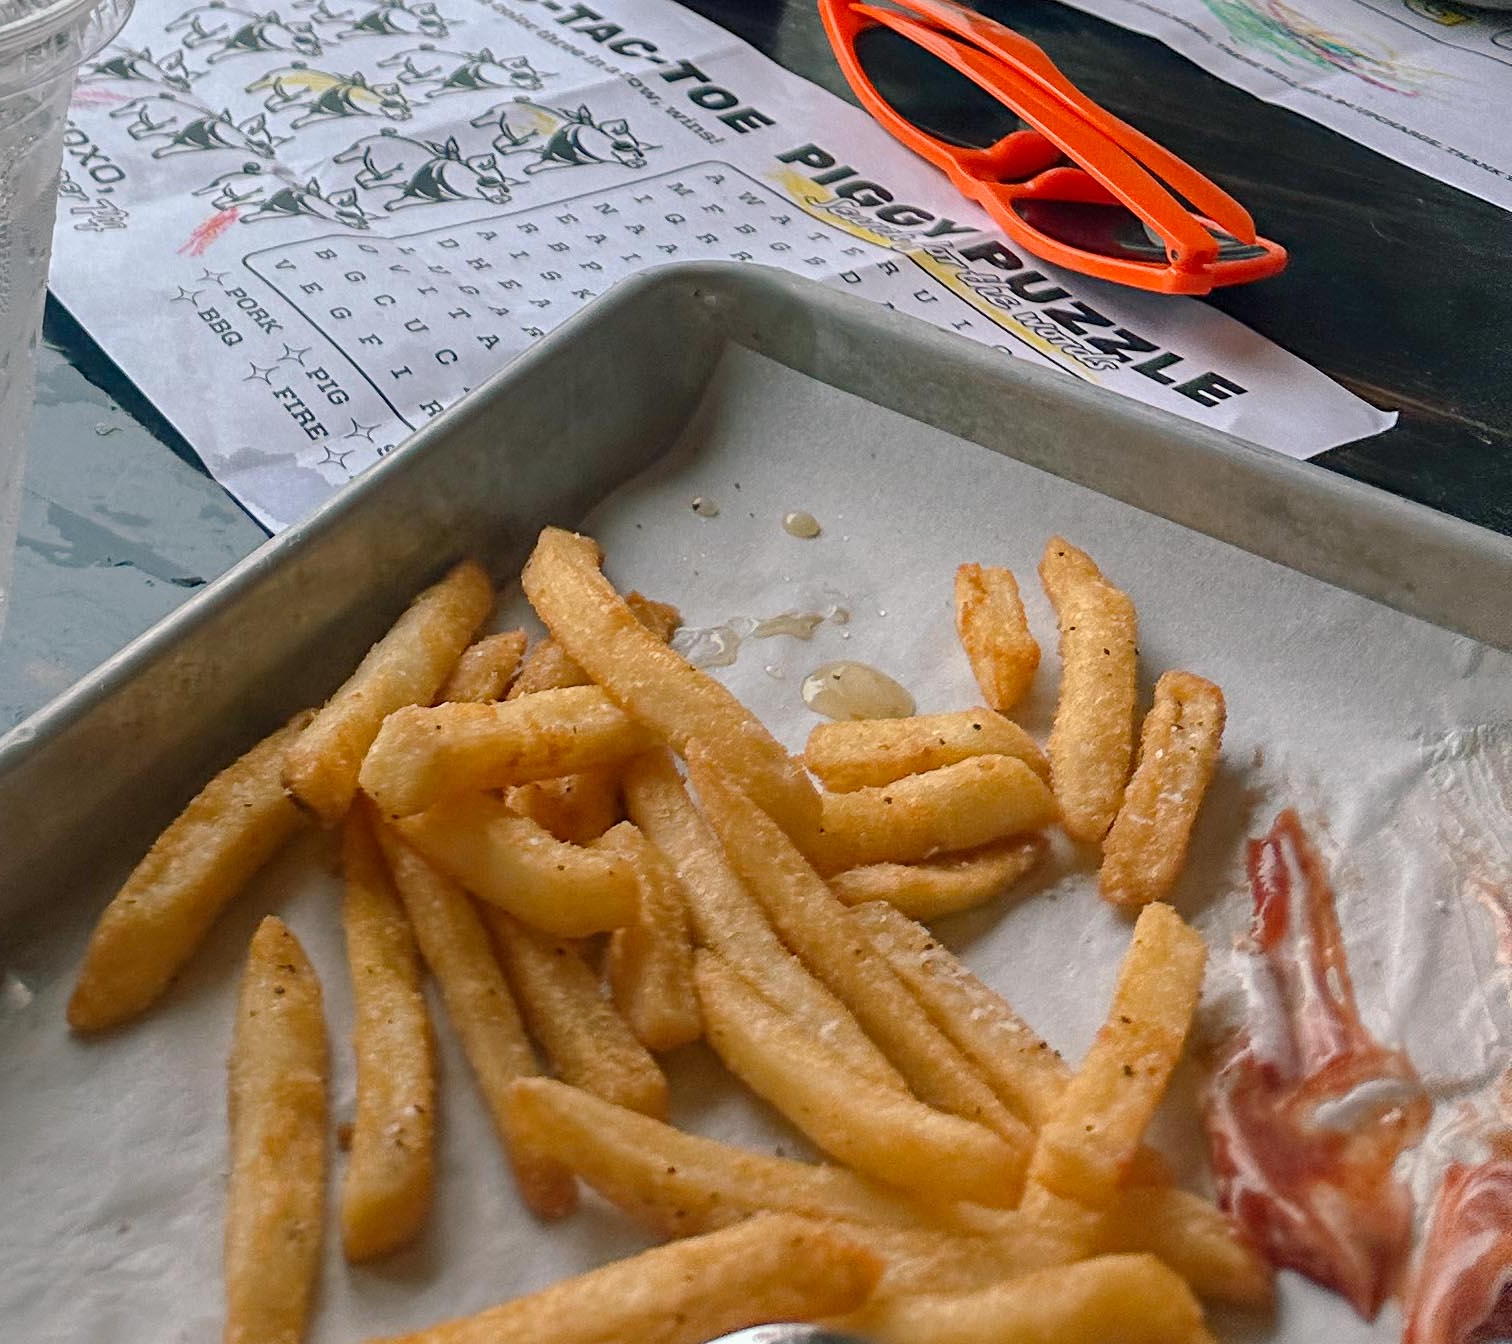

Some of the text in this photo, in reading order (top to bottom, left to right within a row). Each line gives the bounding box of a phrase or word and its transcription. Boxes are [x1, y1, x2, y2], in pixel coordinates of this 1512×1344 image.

[536, 30, 586, 56] three
[584, 55, 606, 69] in
[619, 72, 663, 105] row,
[665, 106, 726, 144] wins!
[63, 119, 126, 193] OXO,
[776, 142, 1249, 408] PIGGY PUZZLE
[955, 271, 1023, 310] the
[1013, 311, 1119, 371] words
[197, 306, 330, 442] BBQ FIRE
[225, 286, 350, 406] PORK PIG
